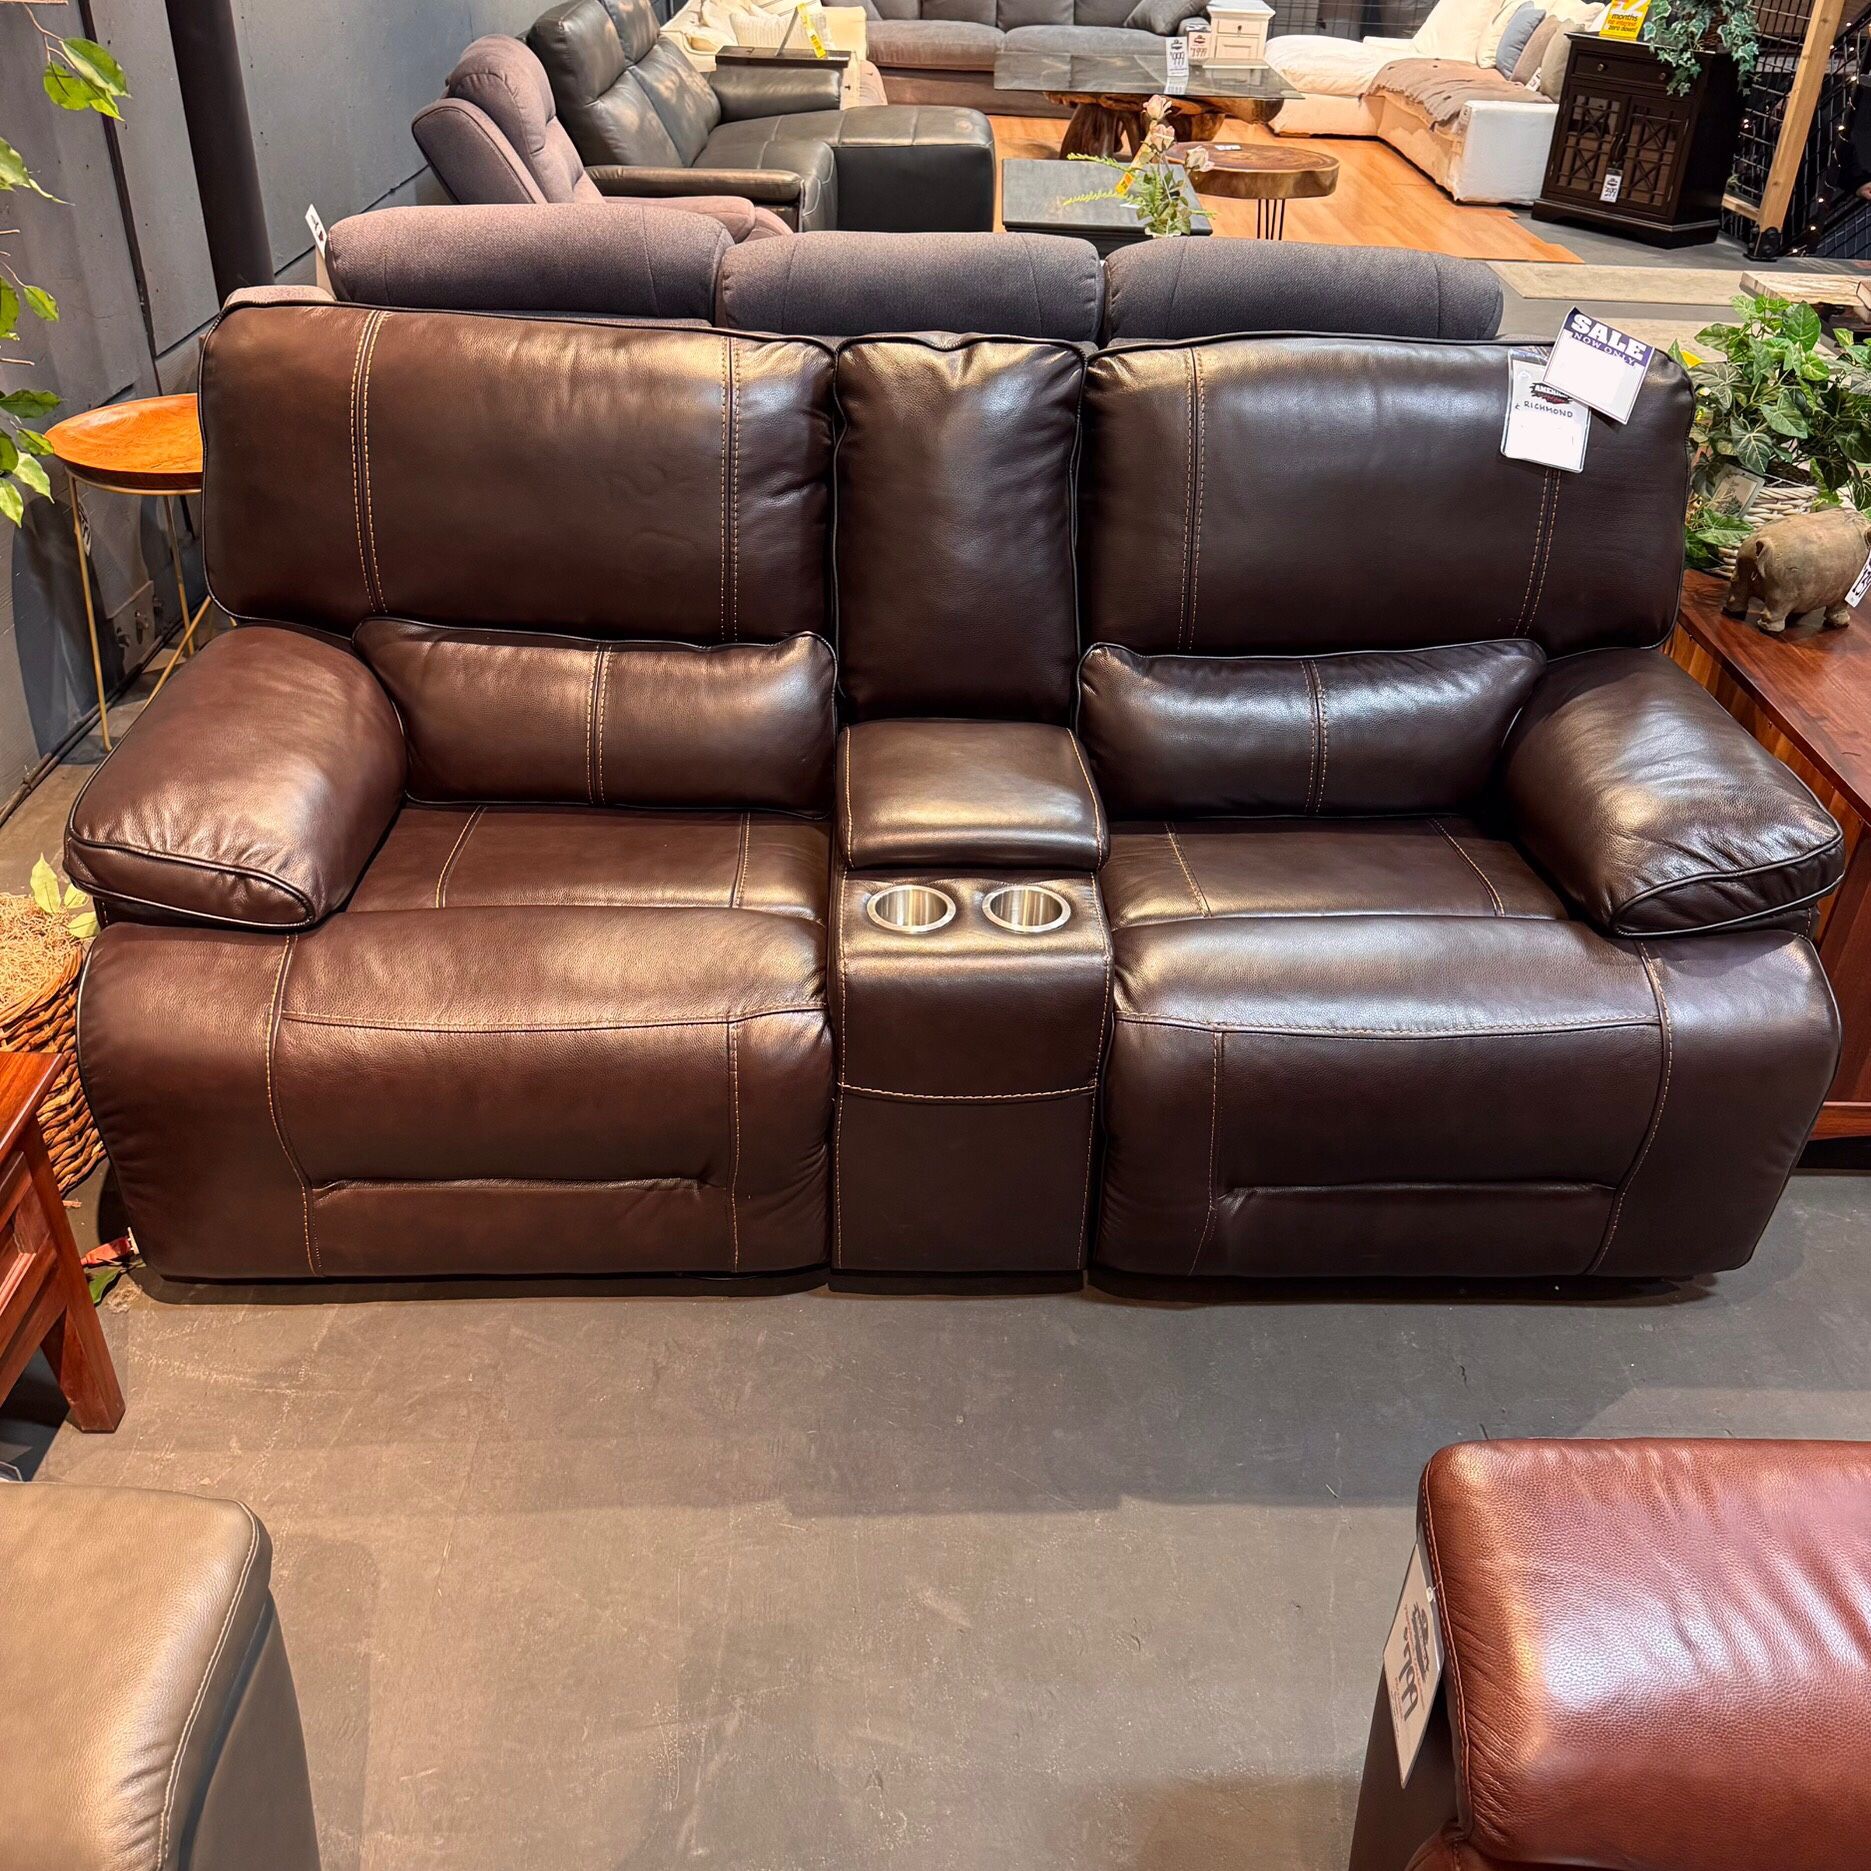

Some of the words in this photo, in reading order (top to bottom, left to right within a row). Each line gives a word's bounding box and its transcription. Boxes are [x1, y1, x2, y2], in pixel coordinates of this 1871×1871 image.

[1611, 13, 1638, 21] months
[1570, 313, 1647, 362] SALE
[1572, 331, 1602, 350] NOW
[1603, 345, 1636, 366] ONLY
[1523, 400, 1574, 418] RICHMOND
